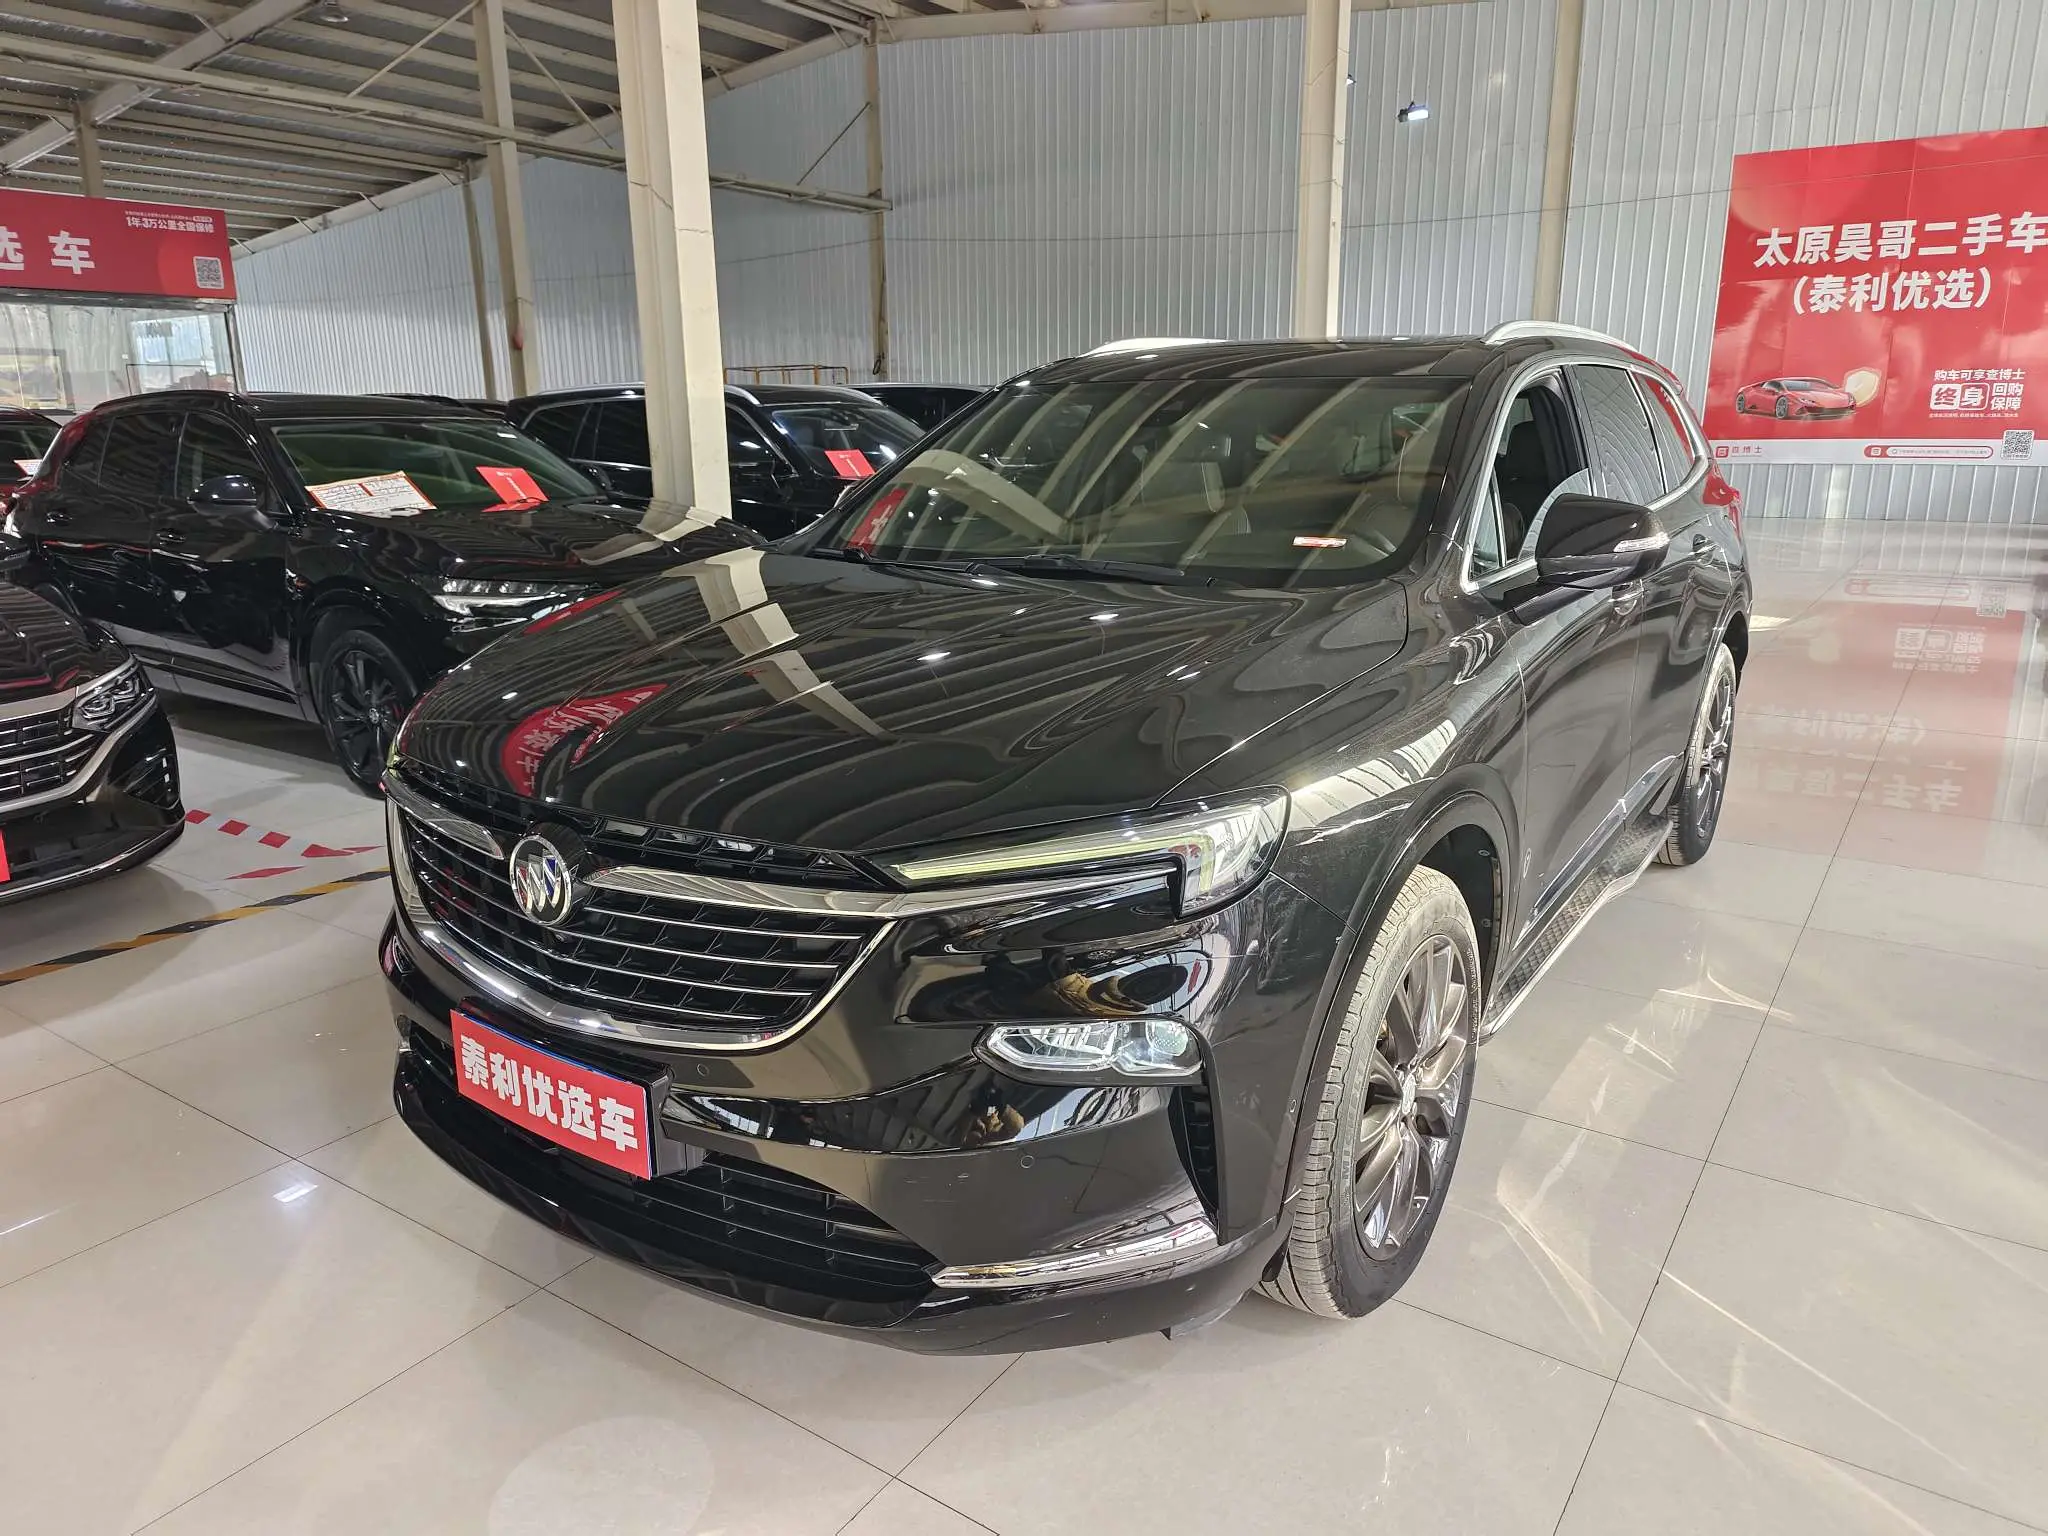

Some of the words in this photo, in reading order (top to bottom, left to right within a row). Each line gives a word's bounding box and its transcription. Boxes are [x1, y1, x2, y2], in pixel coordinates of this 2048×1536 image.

[1754, 212, 2048, 268] 太原昊哥二手车
[1934, 368, 2025, 381] 购车可享查博士
[1932, 385, 1986, 408] 终身
[1992, 382, 2024, 397] 回购
[1990, 397, 2022, 410] 保障
[461, 1034, 637, 1151] 泰利优选车
